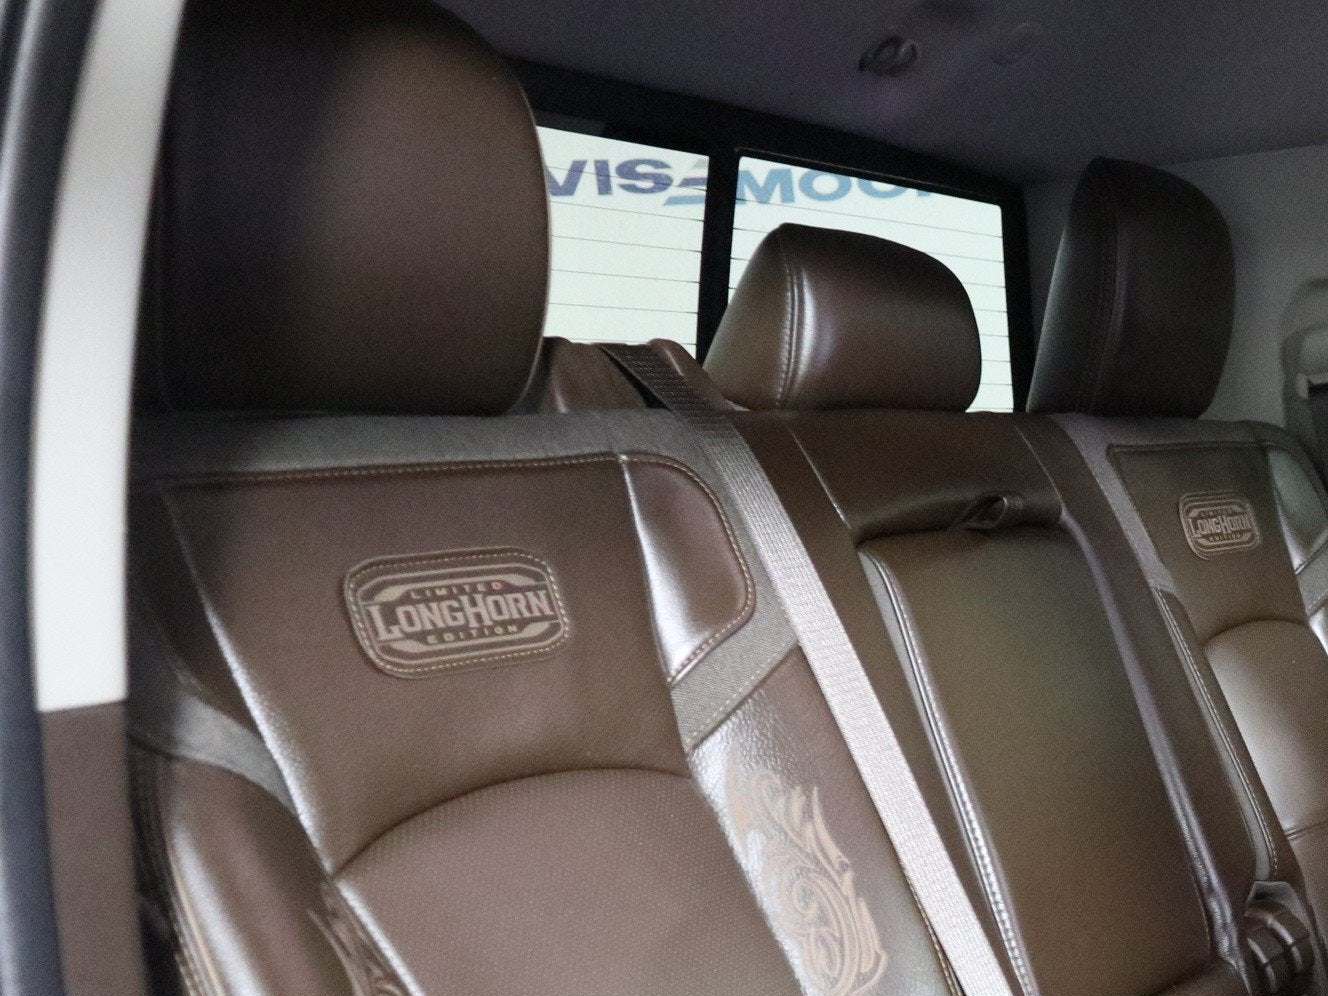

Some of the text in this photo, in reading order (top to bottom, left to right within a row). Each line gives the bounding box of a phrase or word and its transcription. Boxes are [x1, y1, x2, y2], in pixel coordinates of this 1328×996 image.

[735, 167, 930, 205] MOO
[410, 581, 503, 599] LIMITED
[427, 624, 518, 645] EDITION
